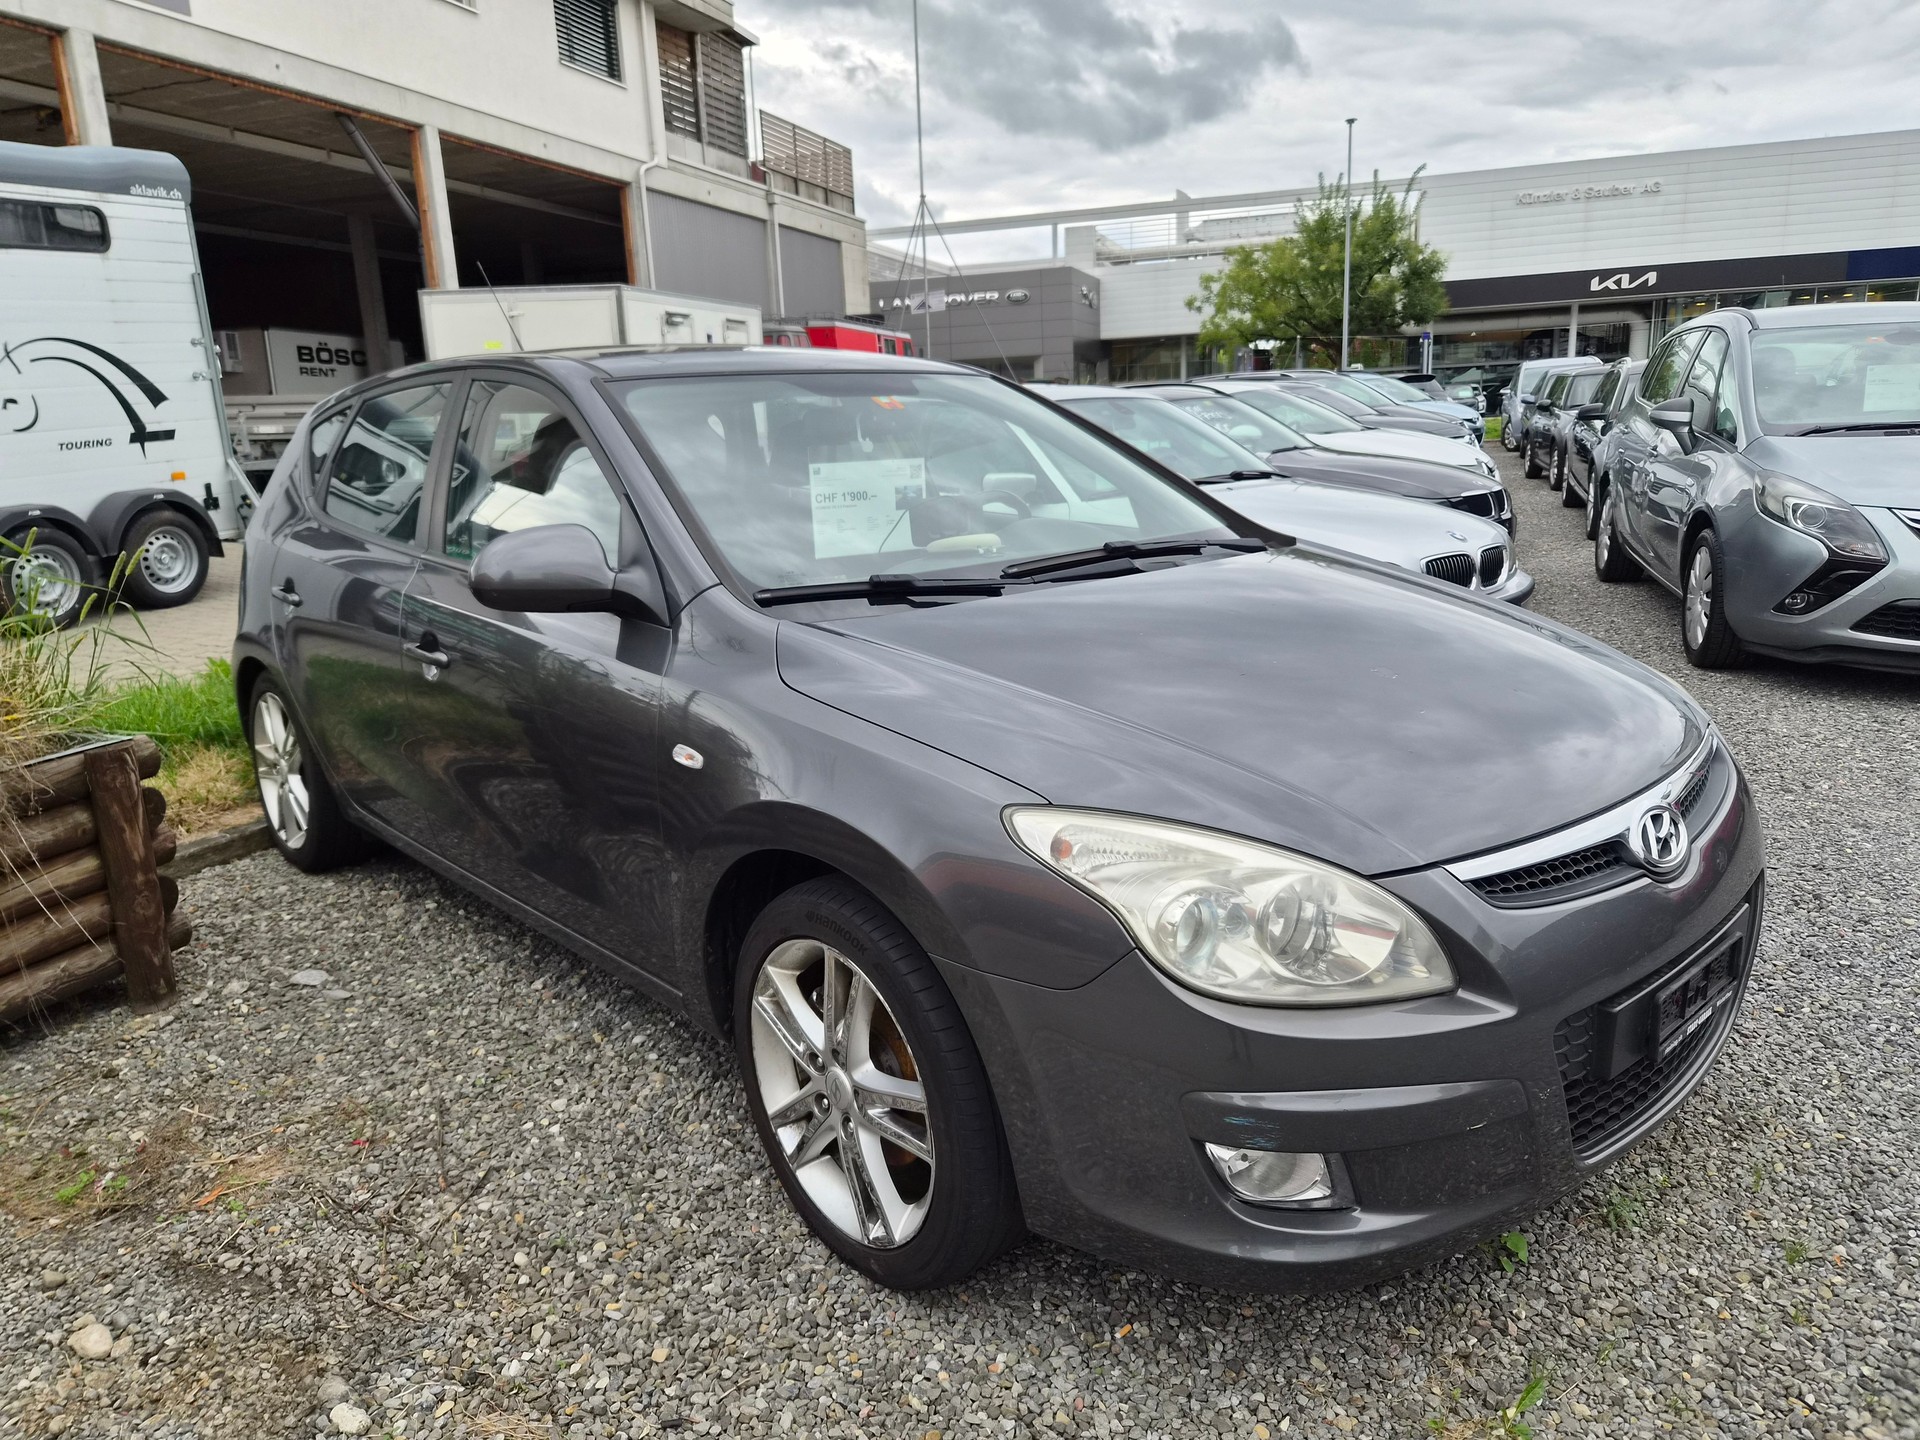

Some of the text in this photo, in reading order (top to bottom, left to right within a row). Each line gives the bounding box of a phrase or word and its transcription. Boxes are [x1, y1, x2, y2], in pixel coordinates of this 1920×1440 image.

[130, 184, 182, 199] aklavik.ch
[1571, 188, 1581, 200] &
[1584, 184, 1635, 198] Sauber
[1640, 181, 1661, 193] AG
[944, 290, 1000, 306] OVER
[296, 342, 367, 367] BÖSC
[299, 367, 336, 378] RENT
[58, 438, 112, 451] TOURING
[816, 493, 838, 504] CHF
